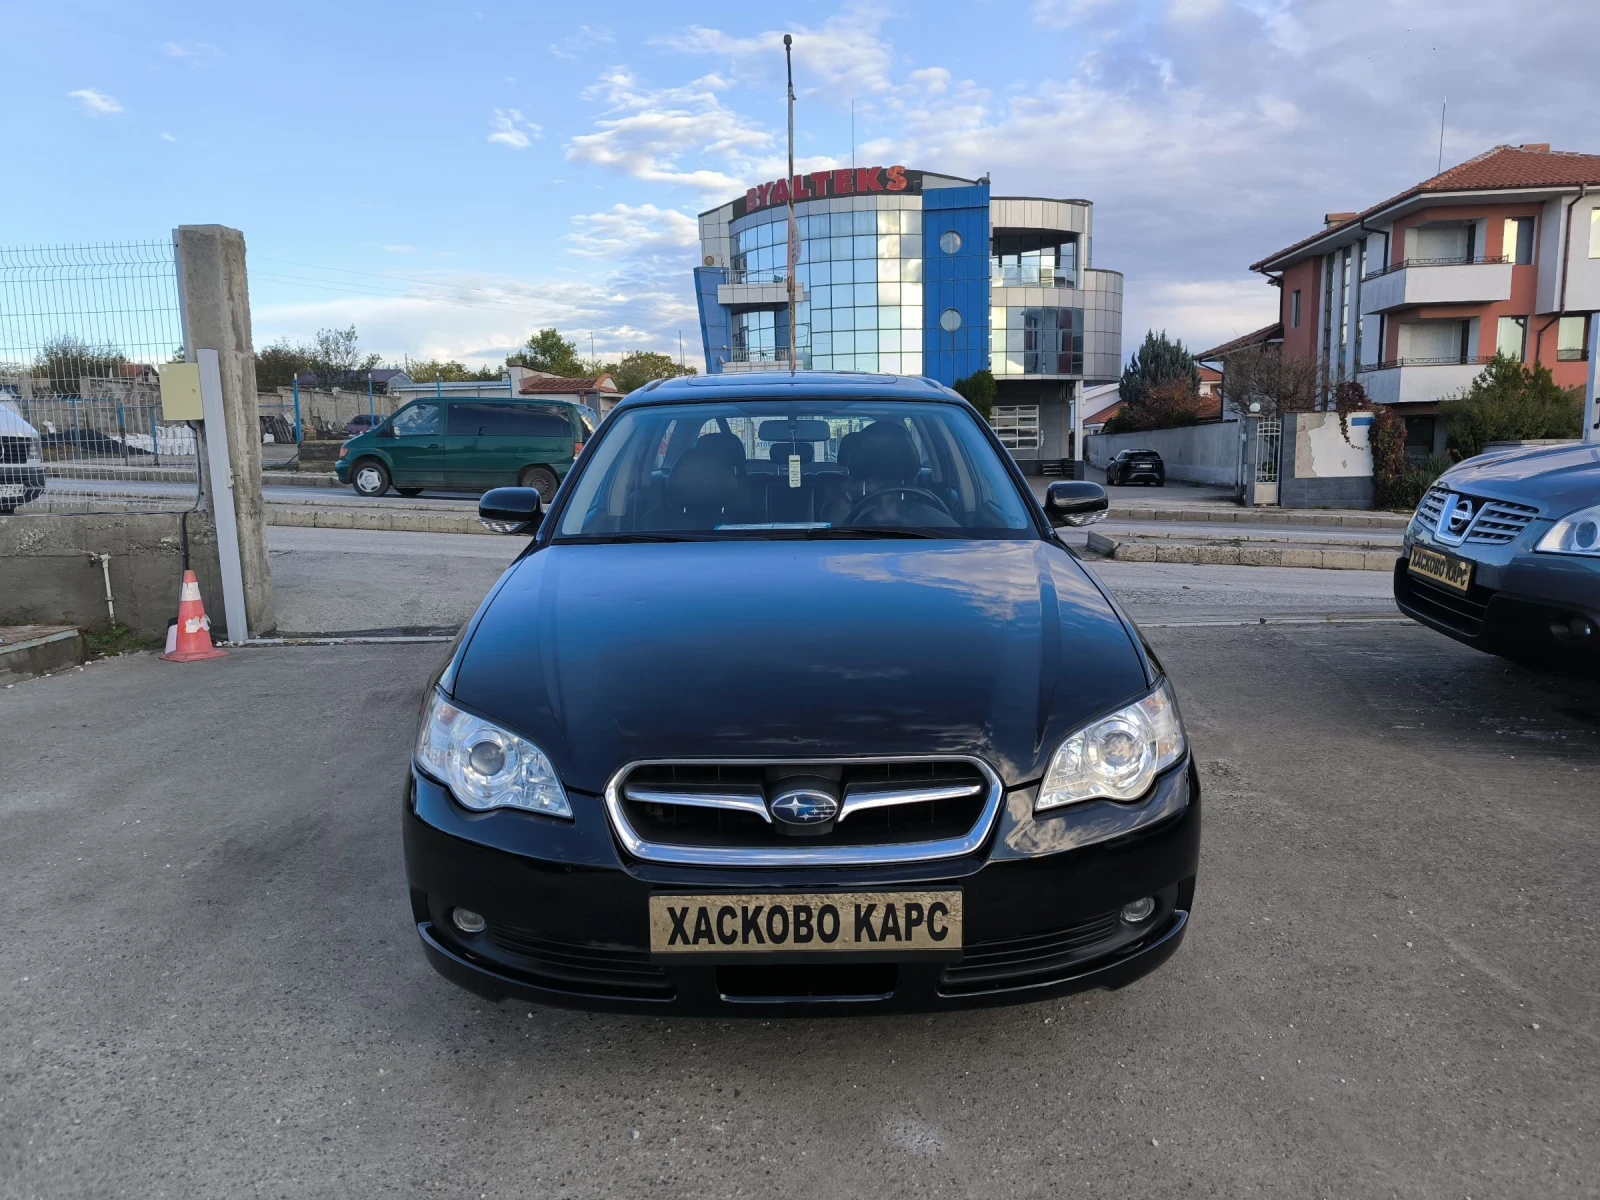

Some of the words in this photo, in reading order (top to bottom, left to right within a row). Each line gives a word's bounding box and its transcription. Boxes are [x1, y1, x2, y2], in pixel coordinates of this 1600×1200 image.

[746, 165, 908, 212] BYALTEKS
[1412, 550, 1445, 577] ХАСКОВО
[1445, 564, 1467, 586] КАРС
[667, 904, 840, 945] ХАСКОВО
[854, 901, 949, 942] КАРС
